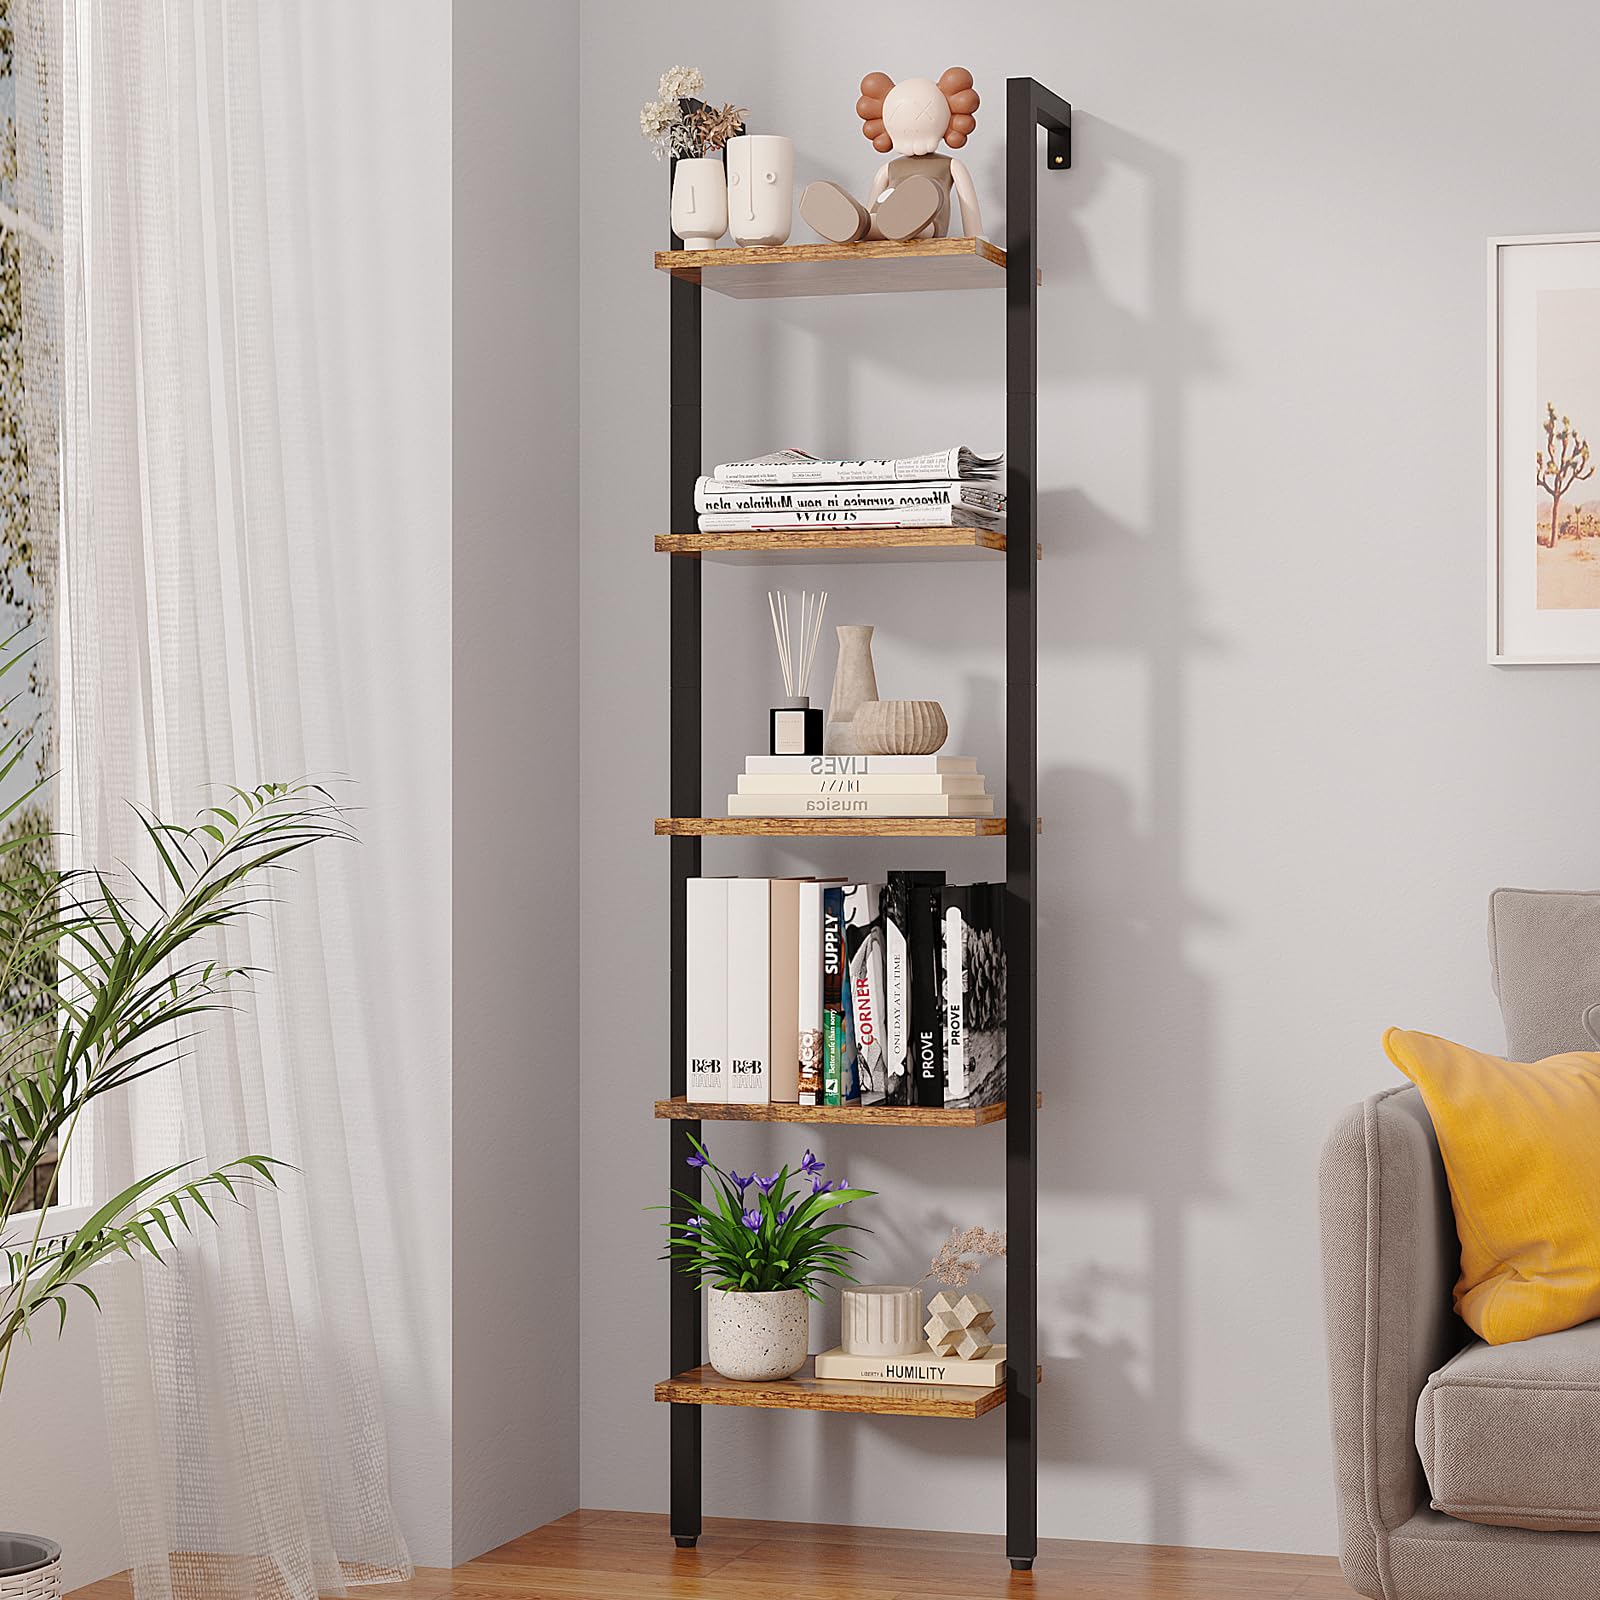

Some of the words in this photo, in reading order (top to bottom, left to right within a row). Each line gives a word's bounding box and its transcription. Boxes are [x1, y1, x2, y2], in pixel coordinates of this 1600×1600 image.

[825, 913, 839, 975] SUPPLY
[893, 954, 901, 980] TIME
[893, 980, 901, 989] A
[893, 990, 901, 1006] AT
[829, 1009, 838, 1026] sorry
[856, 977, 874, 1045] CORNER
[893, 1006, 901, 1029] DAY
[828, 1026, 836, 1041] than
[950, 1005, 961, 1046] PROVE
[828, 1042, 836, 1054] safe
[893, 1031, 901, 1055] ONE
[828, 1055, 836, 1074] Better
[920, 1032, 935, 1079] PROVE
[691, 1059, 721, 1073] B&B
[732, 1060, 762, 1074] B&B
[886, 1364, 946, 1380] HUMILITY
